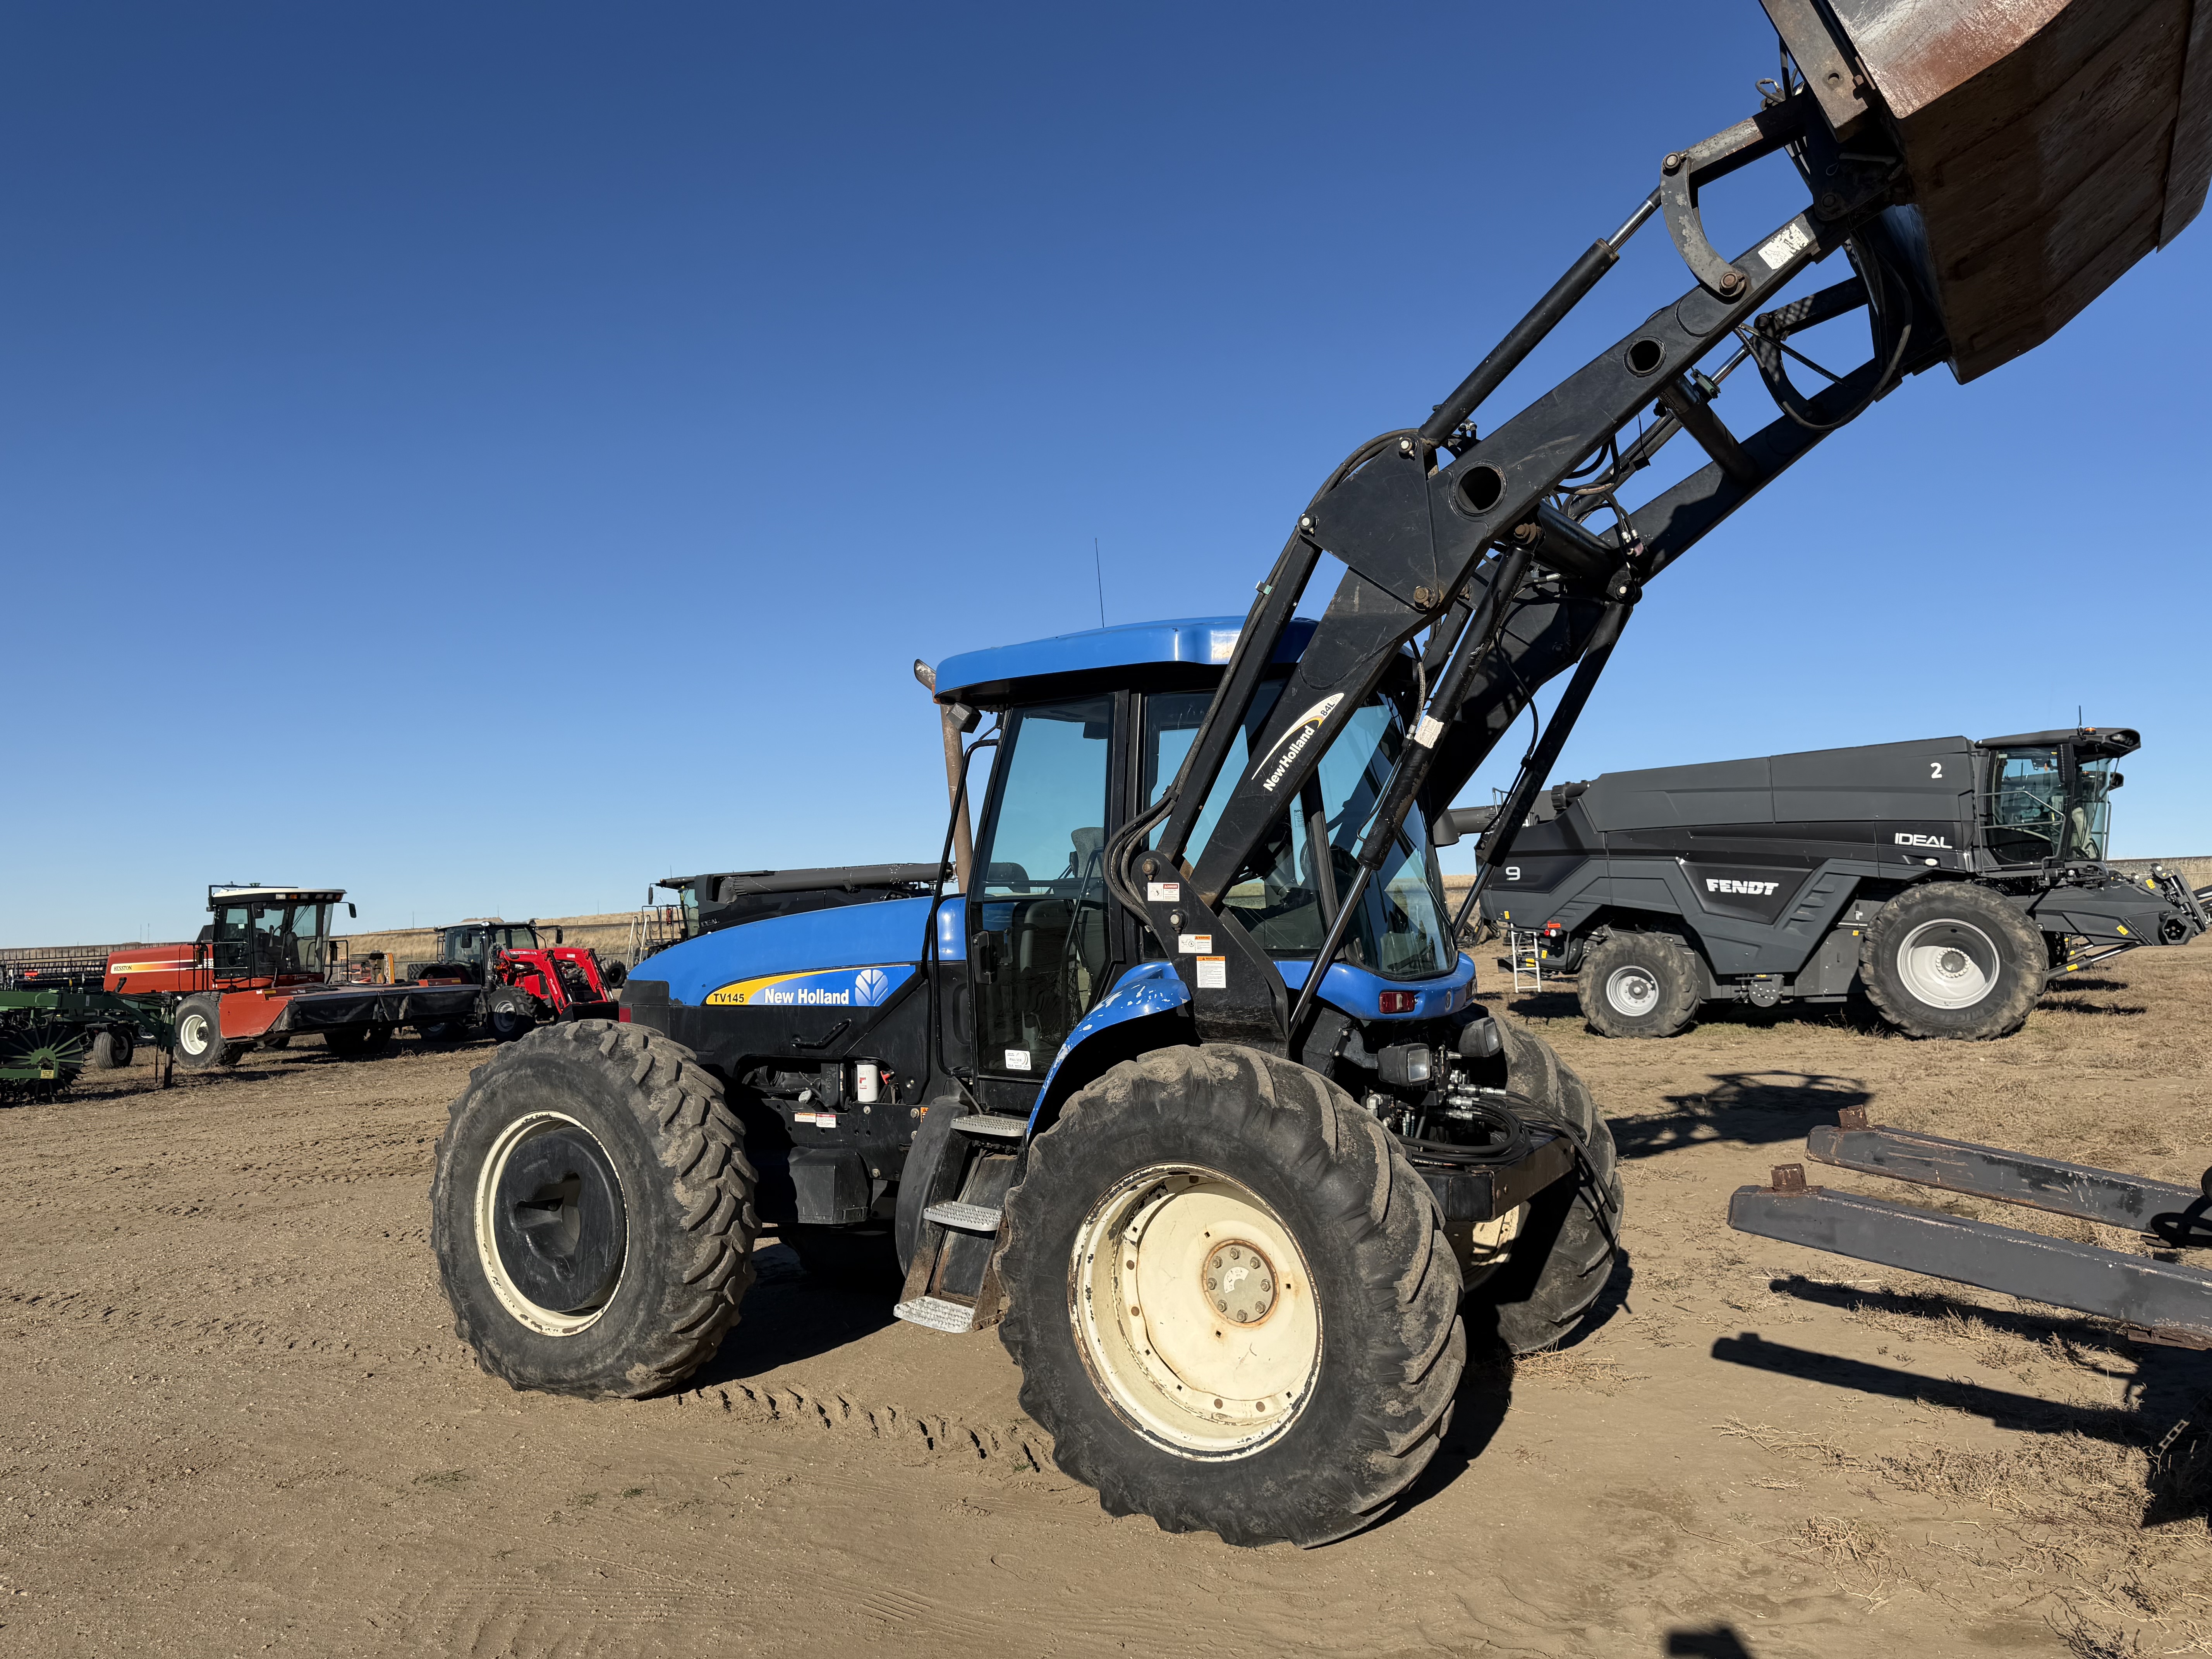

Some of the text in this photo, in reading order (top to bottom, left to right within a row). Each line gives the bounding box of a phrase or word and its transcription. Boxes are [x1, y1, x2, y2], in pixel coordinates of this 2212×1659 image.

[1320, 696, 1339, 716] 84LB
[1263, 725, 1315, 792] New Holland
[1930, 763, 1942, 778] 2
[1895, 833, 1953, 849] IDEAL
[1506, 866, 1520, 881] 9
[1706, 879, 1779, 895] FENDT
[713, 988, 849, 1004] TV145 New Holland
